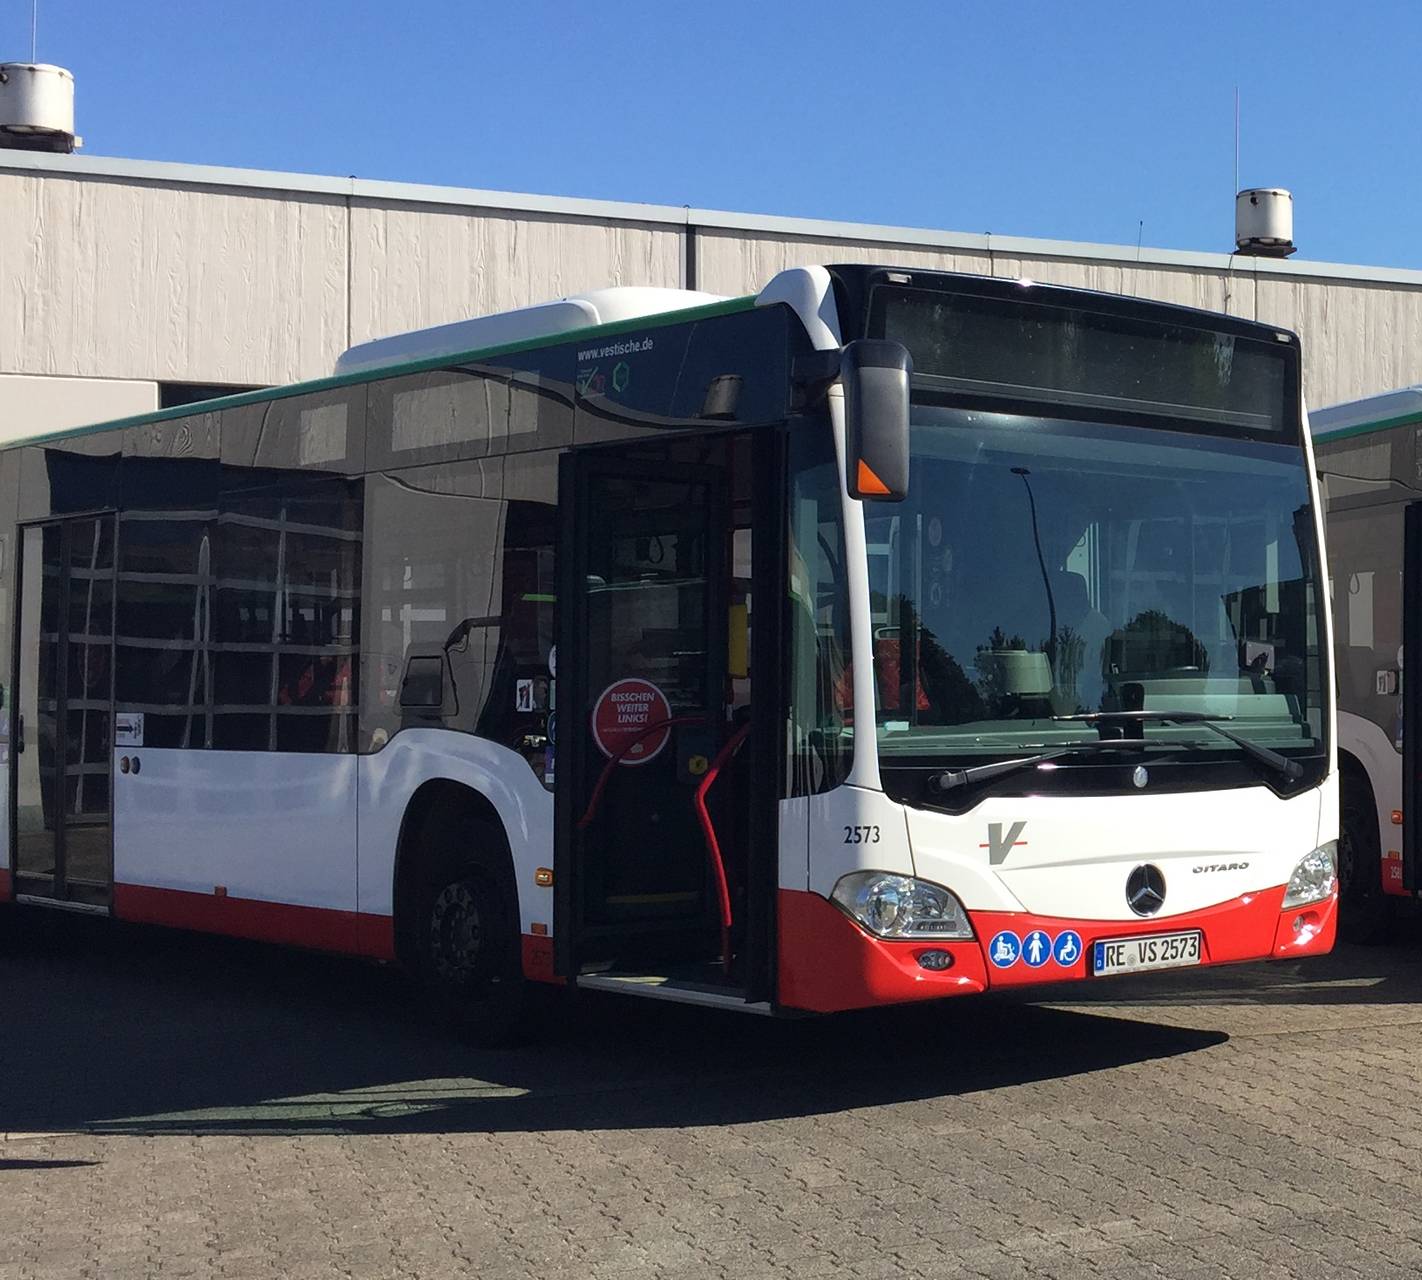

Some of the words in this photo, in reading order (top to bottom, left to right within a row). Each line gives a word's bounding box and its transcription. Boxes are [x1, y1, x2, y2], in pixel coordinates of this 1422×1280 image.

[577, 337, 654, 361] www.vestische.de
[611, 693, 655, 702] BISSCHEN
[617, 703, 649, 713] WEITER
[618, 714, 649, 723] LINKS!
[844, 825, 881, 843] 2573
[1106, 944, 1126, 968] RE
[1138, 940, 1157, 964] VS
[1160, 936, 1198, 961] 2573
